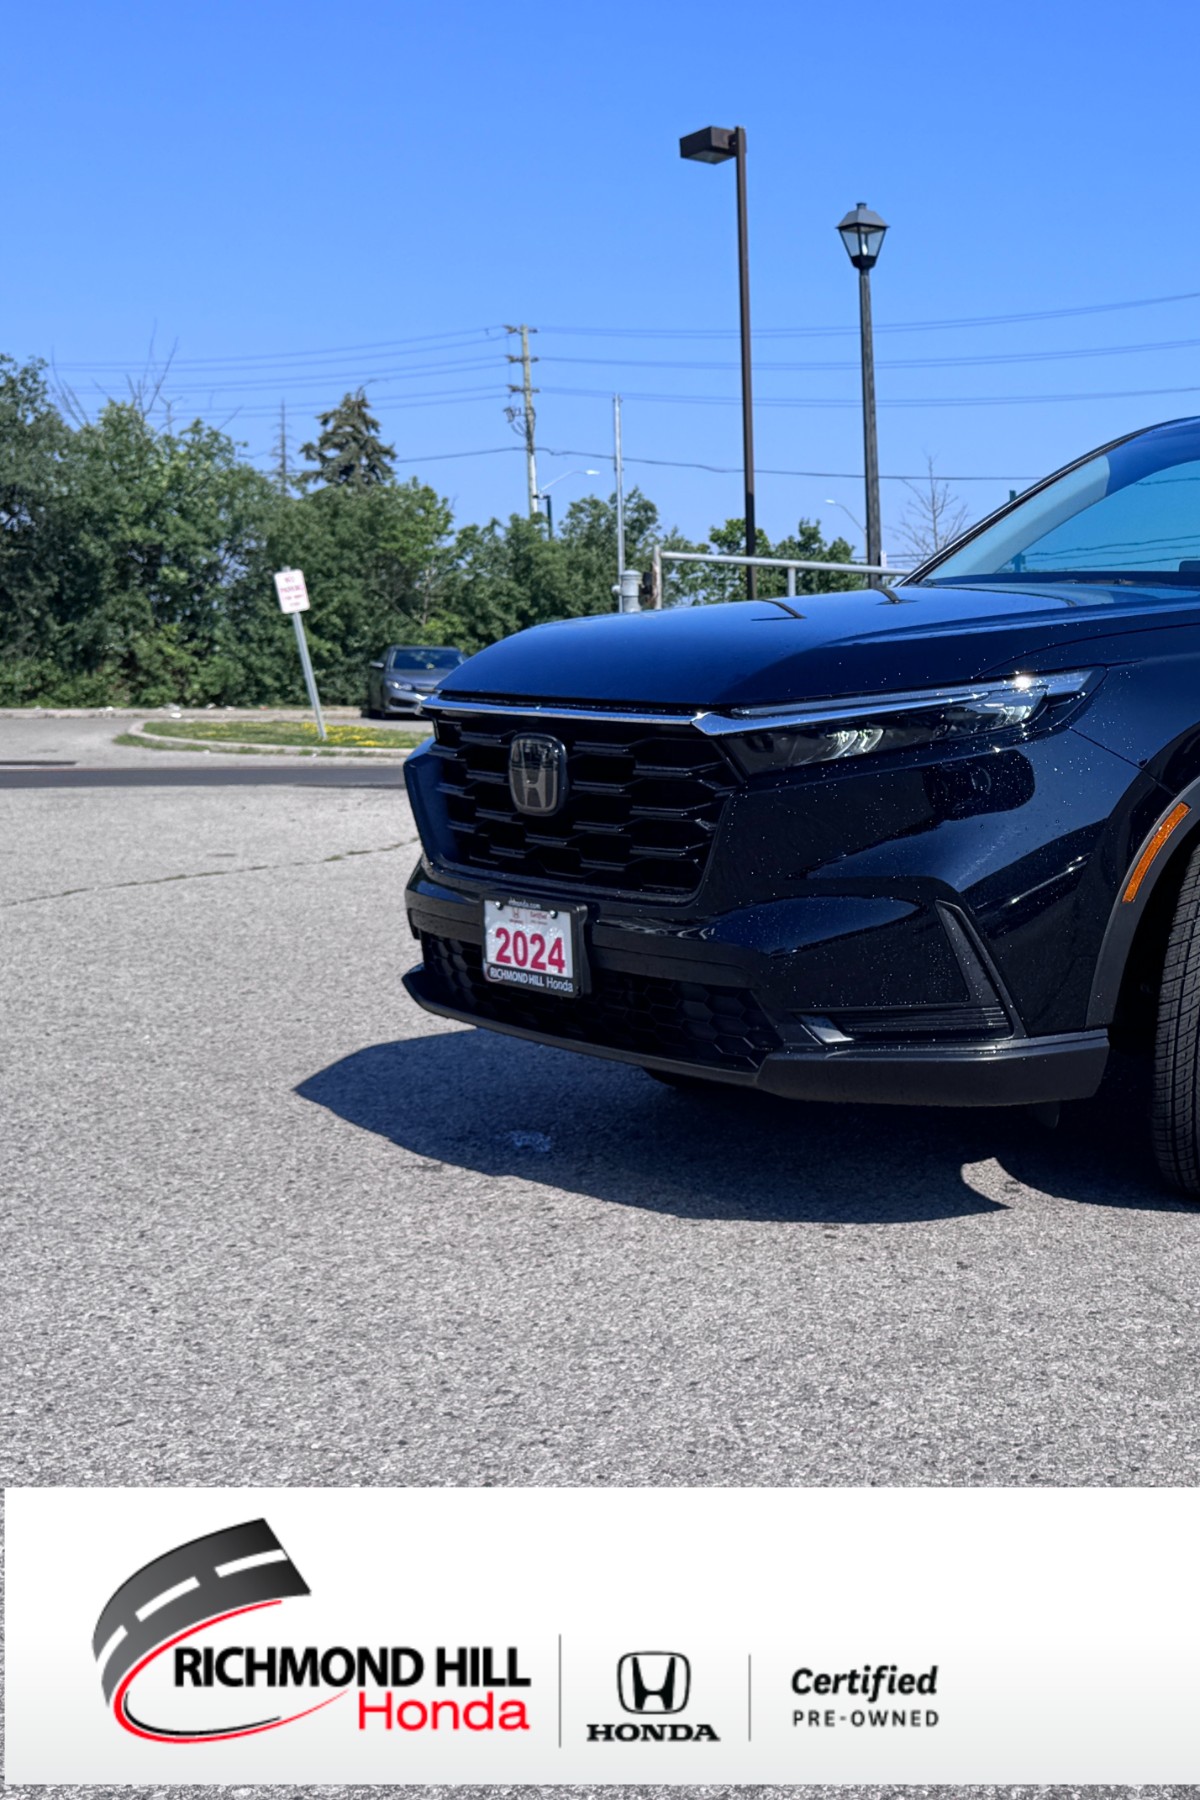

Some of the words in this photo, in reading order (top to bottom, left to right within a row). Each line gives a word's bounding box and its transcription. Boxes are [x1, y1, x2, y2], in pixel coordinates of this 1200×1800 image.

[495, 927, 566, 974] 2024
[489, 967, 528, 985] RICHMOND
[528, 973, 545, 987] HILL
[546, 976, 574, 993] Honda
